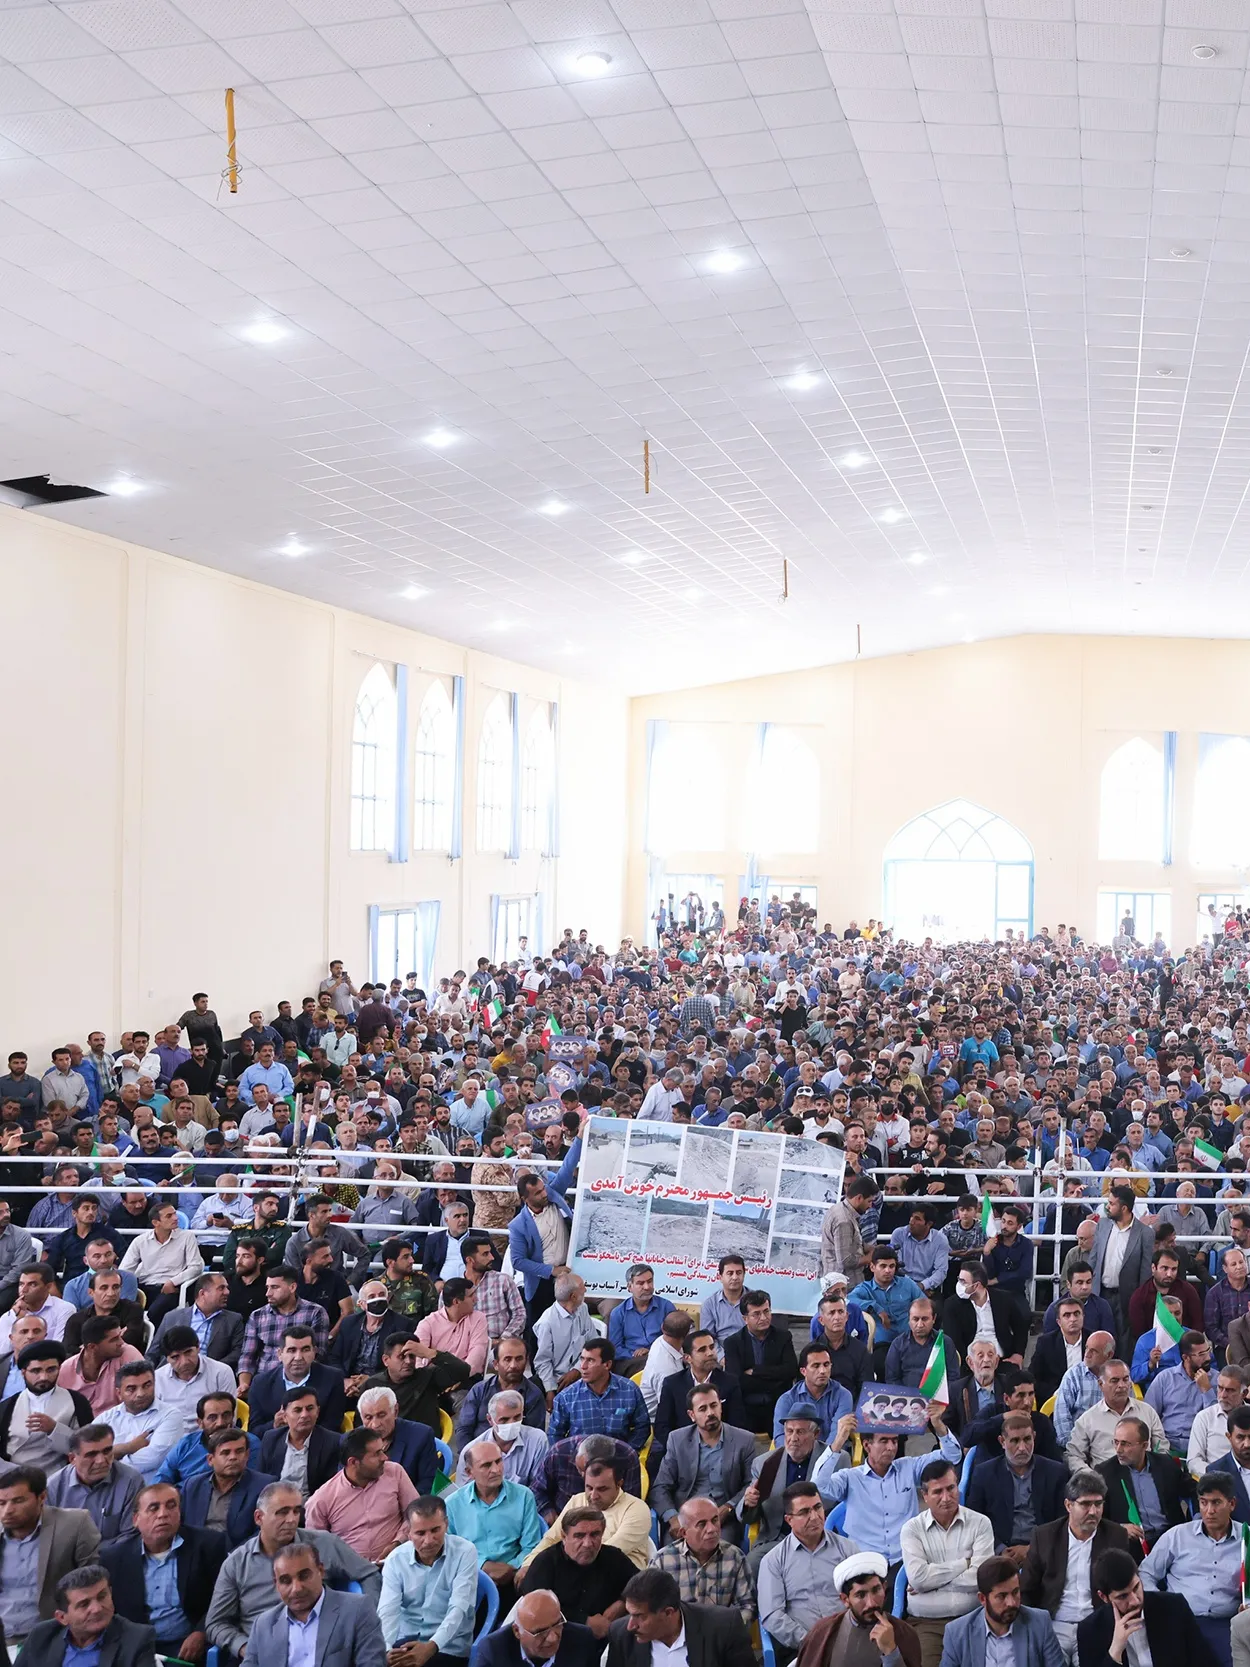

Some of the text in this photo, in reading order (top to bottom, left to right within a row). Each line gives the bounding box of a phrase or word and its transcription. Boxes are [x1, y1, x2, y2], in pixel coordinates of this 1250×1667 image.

[591, 1175, 772, 1208] رئیس جمهور محترم خوش آمدی
[582, 1250, 599, 1261] نیست
[619, 1252, 632, 1263] کس
[632, 1254, 644, 1264] هیچ
[666, 1254, 688, 1265] آسفالت
[687, 1257, 702, 1269] برای
[775, 1267, 795, 1279] وضعیت
[795, 1269, 808, 1277] است
[807, 1270, 817, 1281] این
[655, 1284, 678, 1295] اسلامی
[677, 1286, 698, 1298] شورای
